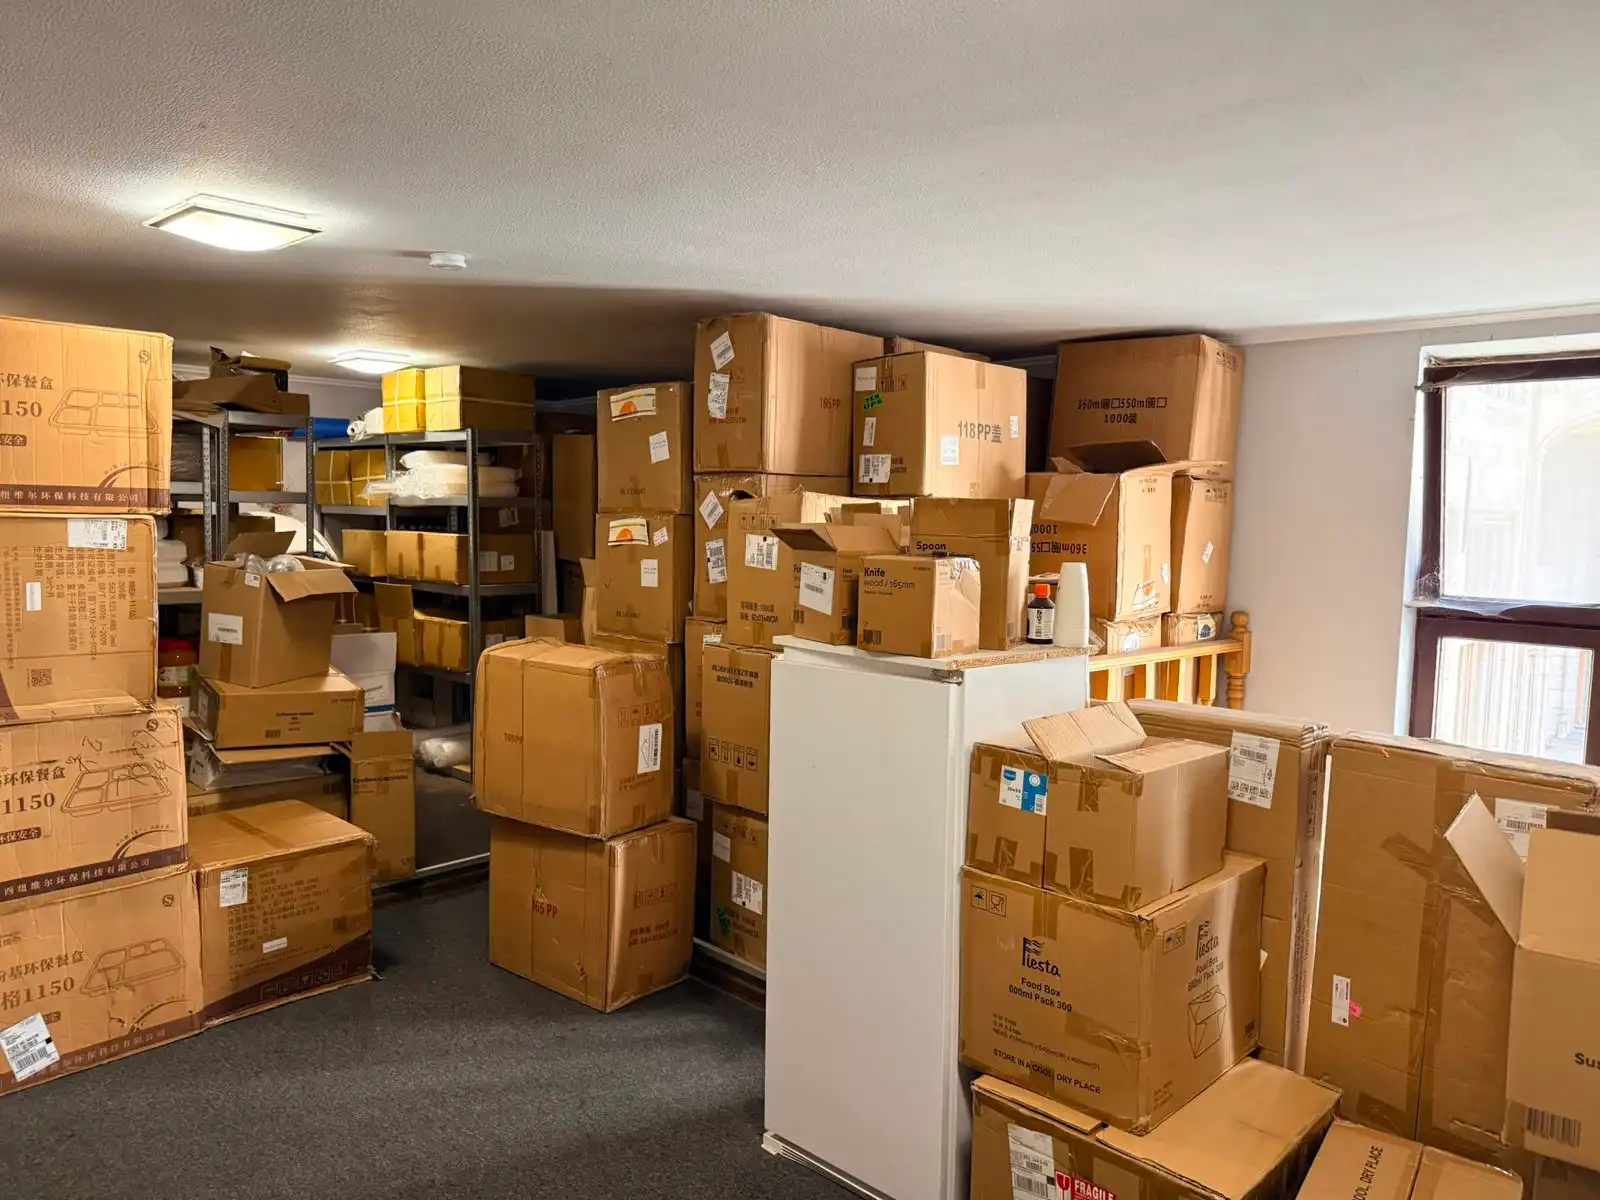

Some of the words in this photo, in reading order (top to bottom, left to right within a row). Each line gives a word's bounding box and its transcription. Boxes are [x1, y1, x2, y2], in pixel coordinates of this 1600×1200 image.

[916, 541, 947, 551] Spoon
[864, 567, 886, 577] Knife
[4, 792, 56, 815] 1150
[1021, 936, 1061, 977] Fiesta
[1021, 977, 1042, 992] Food
[1044, 984, 1061, 997] Box
[1008, 984, 1033, 1001] 600ml
[1035, 994, 1055, 1007] Pack
[1056, 1000, 1072, 1013] 300
[993, 1048, 1016, 1065] STORE
[1017, 1058, 1025, 1067] IN
[1056, 1073, 1072, 1086] DRY
[1074, 1079, 1101, 1094] PLACE
[1365, 1145, 1384, 1170] PLACE
[1360, 1167, 1376, 1184] DRY
[1074, 1178, 1115, 1200] FRAGILE
